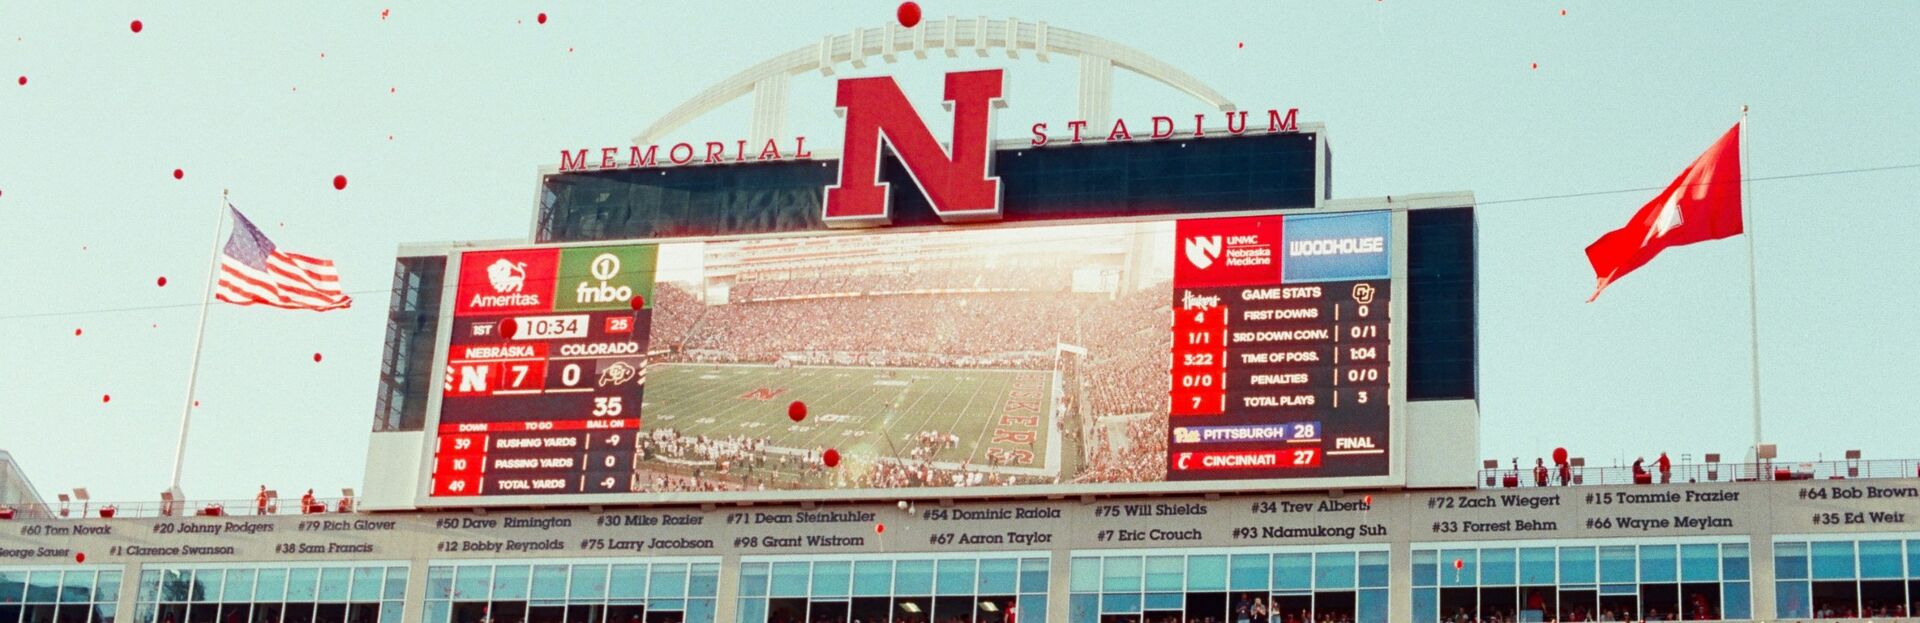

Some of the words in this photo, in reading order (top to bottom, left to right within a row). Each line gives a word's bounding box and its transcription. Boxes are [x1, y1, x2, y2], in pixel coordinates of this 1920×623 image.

[1031, 108, 1299, 146] STADIUM
[822, 68, 1004, 224] N
[558, 136, 812, 171] MEMORIAL
[1226, 235, 1258, 245] UNMC
[1289, 236, 1384, 256] WOODHOUSE
[1226, 248, 1271, 257] Nebraska
[1226, 256, 1271, 266] Medicine
[577, 282, 632, 303] fnbo
[1242, 289, 1280, 300] GAME
[1282, 287, 1322, 299] STATS
[1194, 313, 1204, 323] 4
[1244, 309, 1274, 320] FIRST
[1275, 308, 1318, 319] DOWNS
[1359, 306, 1368, 317] 0
[473, 324, 493, 336] 1ST
[526, 319, 578, 335] 10:34
[610, 319, 627, 331] 25
[1233, 332, 1256, 343] 3RD
[1256, 331, 1294, 341] DOWN
[1294, 329, 1329, 340] CONV.
[465, 346, 534, 359] NEBRASKA
[560, 342, 638, 355] COLORADO
[1350, 347, 1376, 360] 1:04
[1184, 354, 1213, 366] 3:22
[1241, 353, 1269, 363] TIME
[1269, 352, 1285, 363] OF
[1286, 352, 1319, 362] POSS.
[459, 365, 488, 392] N
[511, 365, 529, 388] 7
[561, 364, 581, 387] 0
[1250, 374, 1308, 385] PENALTIES
[1192, 397, 1202, 409] 7
[1244, 396, 1280, 407] TOTAL
[1280, 395, 1315, 406] PLAYS
[1357, 391, 1368, 403] 3
[592, 397, 622, 416] 35
[525, 422, 538, 430] TO
[538, 421, 553, 429] GO
[610, 420, 624, 428] ON
[1204, 427, 1284, 440] PITTSBURGH
[1294, 425, 1314, 438] 28
[455, 439, 471, 449] 39
[497, 438, 541, 448] RUSHING
[543, 437, 577, 447] YARDS
[606, 435, 620, 446] -9
[1336, 438, 1374, 449] FINAL
[454, 459, 466, 470] 10
[495, 459, 538, 469] PASSING
[540, 458, 573, 467] YARDS
[605, 456, 615, 467] 0
[1203, 454, 1275, 467] CINCINNATI
[1293, 451, 1314, 465] 27
[449, 480, 465, 491] 49
[499, 480, 531, 489] TOTAL
[532, 479, 566, 488] YARDS
[600, 478, 615, 488] -9
[1585, 493, 1612, 504] #15
[1616, 492, 1681, 503] Tommie
[1685, 490, 1740, 502] Frazier
[1799, 488, 1828, 500] #64
[1832, 487, 1863, 499] Bob
[1867, 486, 1919, 498] Brown
[1251, 502, 1277, 513] #34
[1281, 501, 1313, 512] Trev
[1428, 496, 1454, 509] #72
[1458, 495, 1496, 507] Zach
[1500, 494, 1561, 508] Wiegert
[923, 509, 948, 521] #54
[952, 509, 1012, 520] Dominic
[1015, 508, 1061, 519] Raiola
[1095, 505, 1120, 517] #75
[1124, 505, 1151, 516] Will
[1156, 503, 1208, 515] Shields
[436, 518, 459, 529] #50
[462, 518, 497, 529] Dave
[504, 516, 572, 529] Rimington
[597, 515, 621, 526] #30
[624, 515, 658, 526] Mike
[662, 514, 704, 525] Rozier
[727, 513, 749, 524] #71
[755, 512, 792, 523] Dean
[796, 511, 876, 523] Steinkuhler
[1585, 517, 1612, 529] #66
[1616, 517, 1670, 531] Wayne
[1674, 516, 1733, 530] Meylan
[1813, 513, 1840, 525] #35
[1845, 513, 1864, 523] Ed
[1869, 512, 1905, 523] Weir
[21, 525, 41, 535] #60
[45, 525, 69, 535] Tom
[73, 524, 112, 535] Novak
[153, 523, 174, 534] #20
[177, 522, 222, 535] Johnny
[224, 521, 274, 534] Rodgers
[298, 521, 320, 531] #79
[323, 520, 351, 531] Rich
[354, 519, 396, 530] Glover
[1232, 527, 1258, 539] #93
[1262, 525, 1355, 539] Ndamukong
[1359, 524, 1387, 536] Suh
[1432, 522, 1457, 533] #33
[1463, 520, 1511, 532] Forrest
[1515, 520, 1557, 531] Behm
[930, 533, 954, 544] #67
[958, 533, 1003, 544] Aaron
[1007, 532, 1053, 545] Taylor
[1098, 530, 1114, 541] #7
[1118, 530, 1146, 541] Eric
[1150, 528, 1202, 540] Crouch
[276, 543, 295, 553] #38
[298, 543, 325, 553] Sam
[328, 542, 373, 553] Francis
[438, 542, 457, 552] #12
[462, 541, 503, 552] Bobby
[506, 540, 564, 552] Reynolds
[581, 539, 604, 549] #75
[608, 539, 644, 552] Larry
[648, 537, 714, 549] Jacobson
[733, 537, 757, 548] #98
[762, 536, 801, 547] Grant
[807, 535, 864, 546] Wistrom
[37, 547, 70, 557] Sauer
[110, 546, 122, 556] #1
[126, 546, 179, 556] Clarence
[182, 545, 234, 556] Swanson
